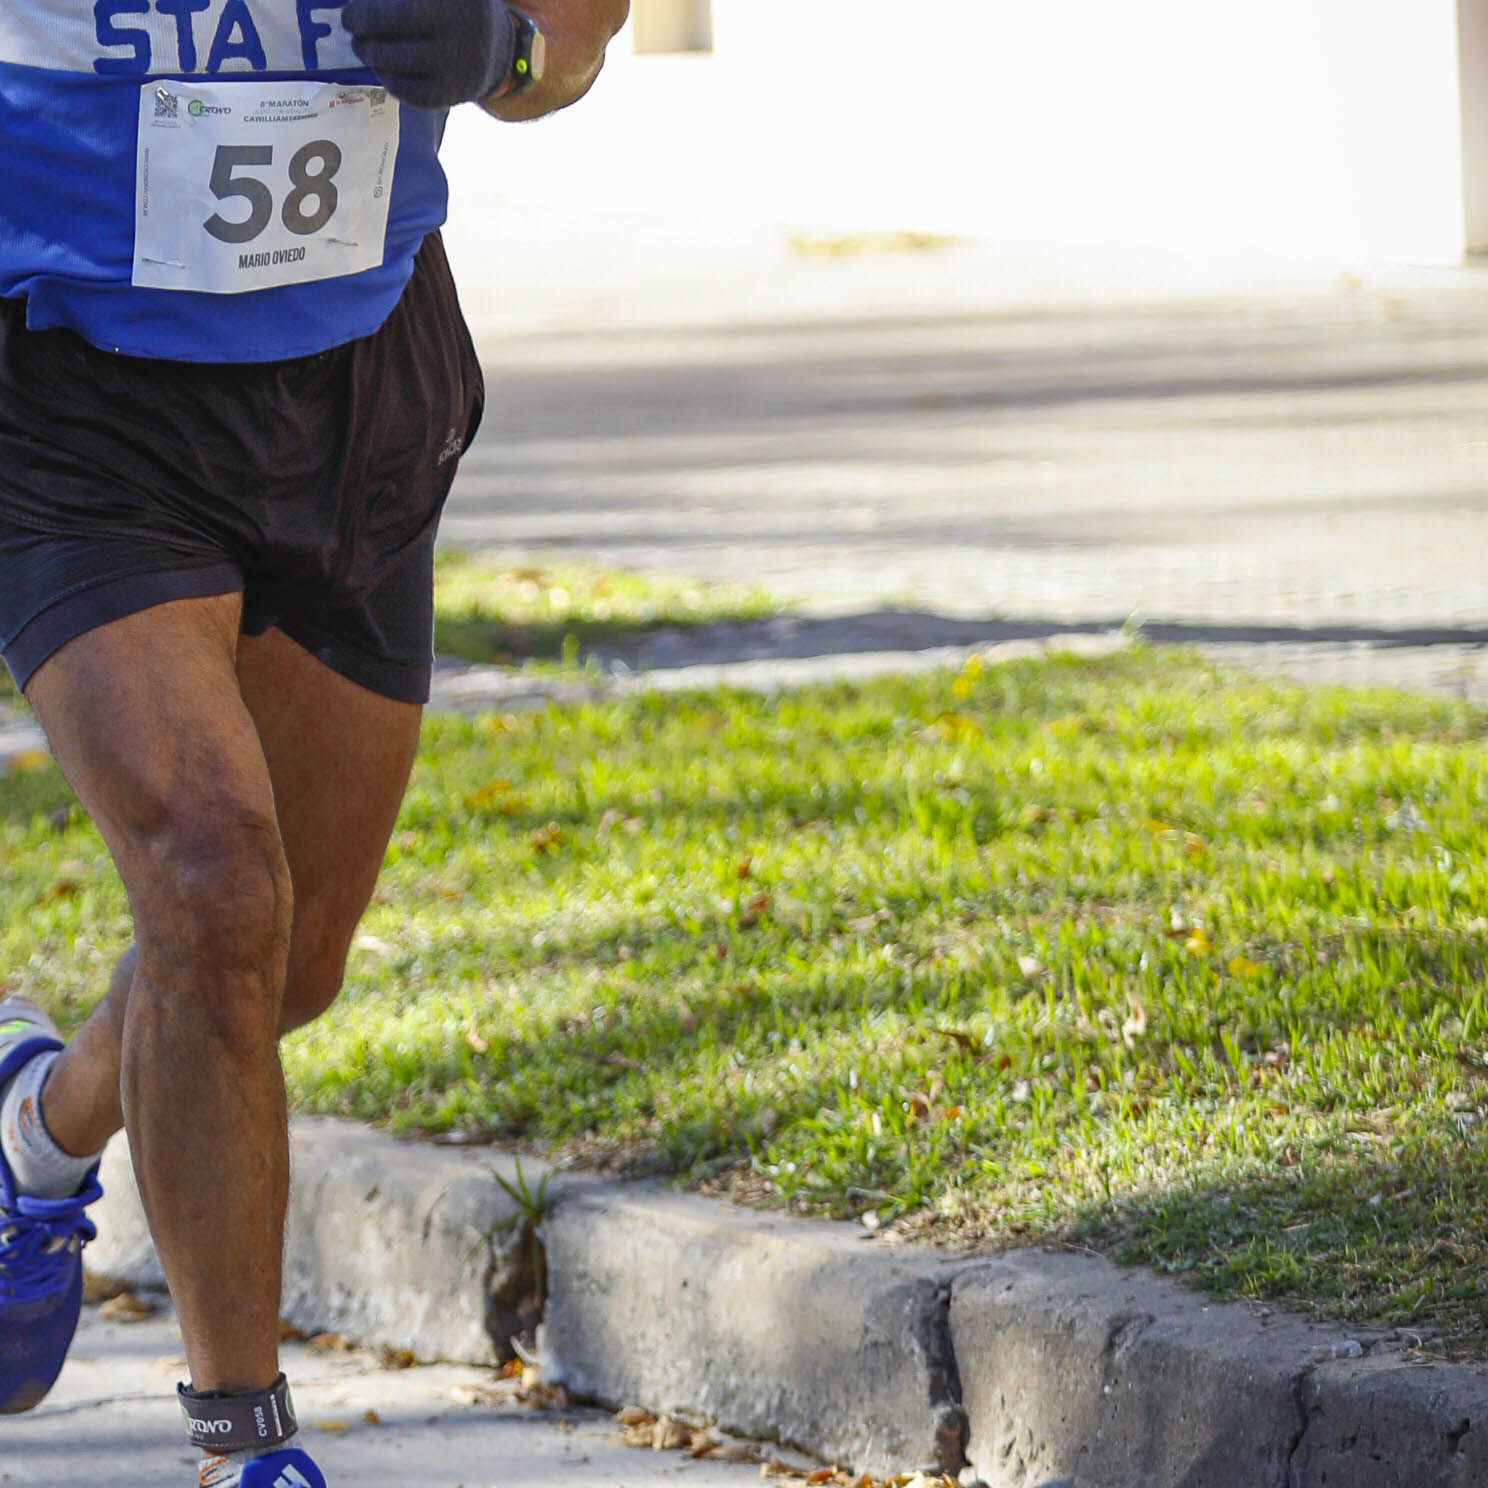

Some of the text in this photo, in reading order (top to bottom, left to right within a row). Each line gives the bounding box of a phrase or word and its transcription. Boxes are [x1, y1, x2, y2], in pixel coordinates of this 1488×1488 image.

[202, 139, 342, 244] 58
[238, 246, 306, 269] MARIO OVIEDO
